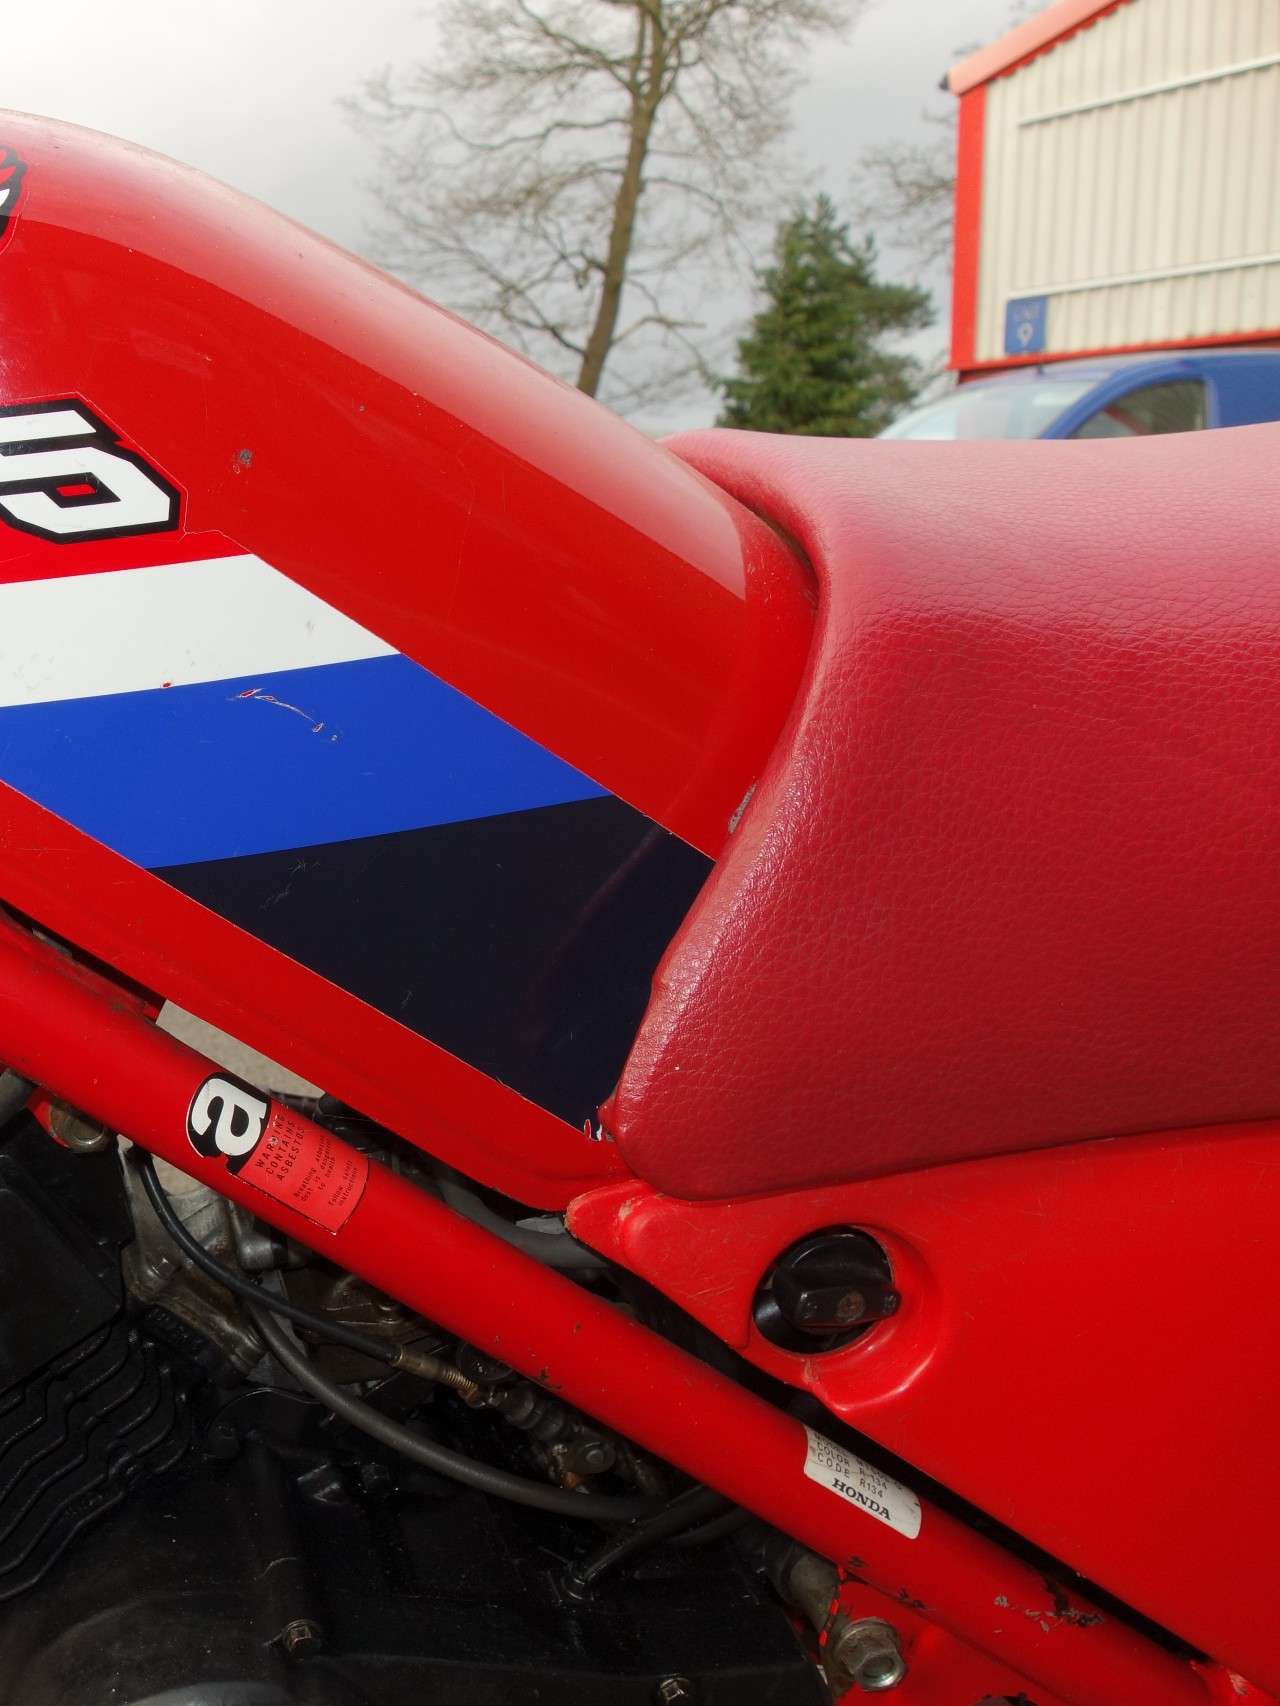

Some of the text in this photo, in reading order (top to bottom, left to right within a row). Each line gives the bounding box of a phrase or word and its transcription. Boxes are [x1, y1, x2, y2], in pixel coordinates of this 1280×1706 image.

[191, 1078, 267, 1156] a
[266, 1121, 296, 1174] CONTAINS
[276, 1127, 305, 1181] ASBESTOS
[817, 1441, 850, 1466] COLOR
[817, 1452, 883, 1498] CODE R134
[832, 1477, 890, 1520] HONDA
